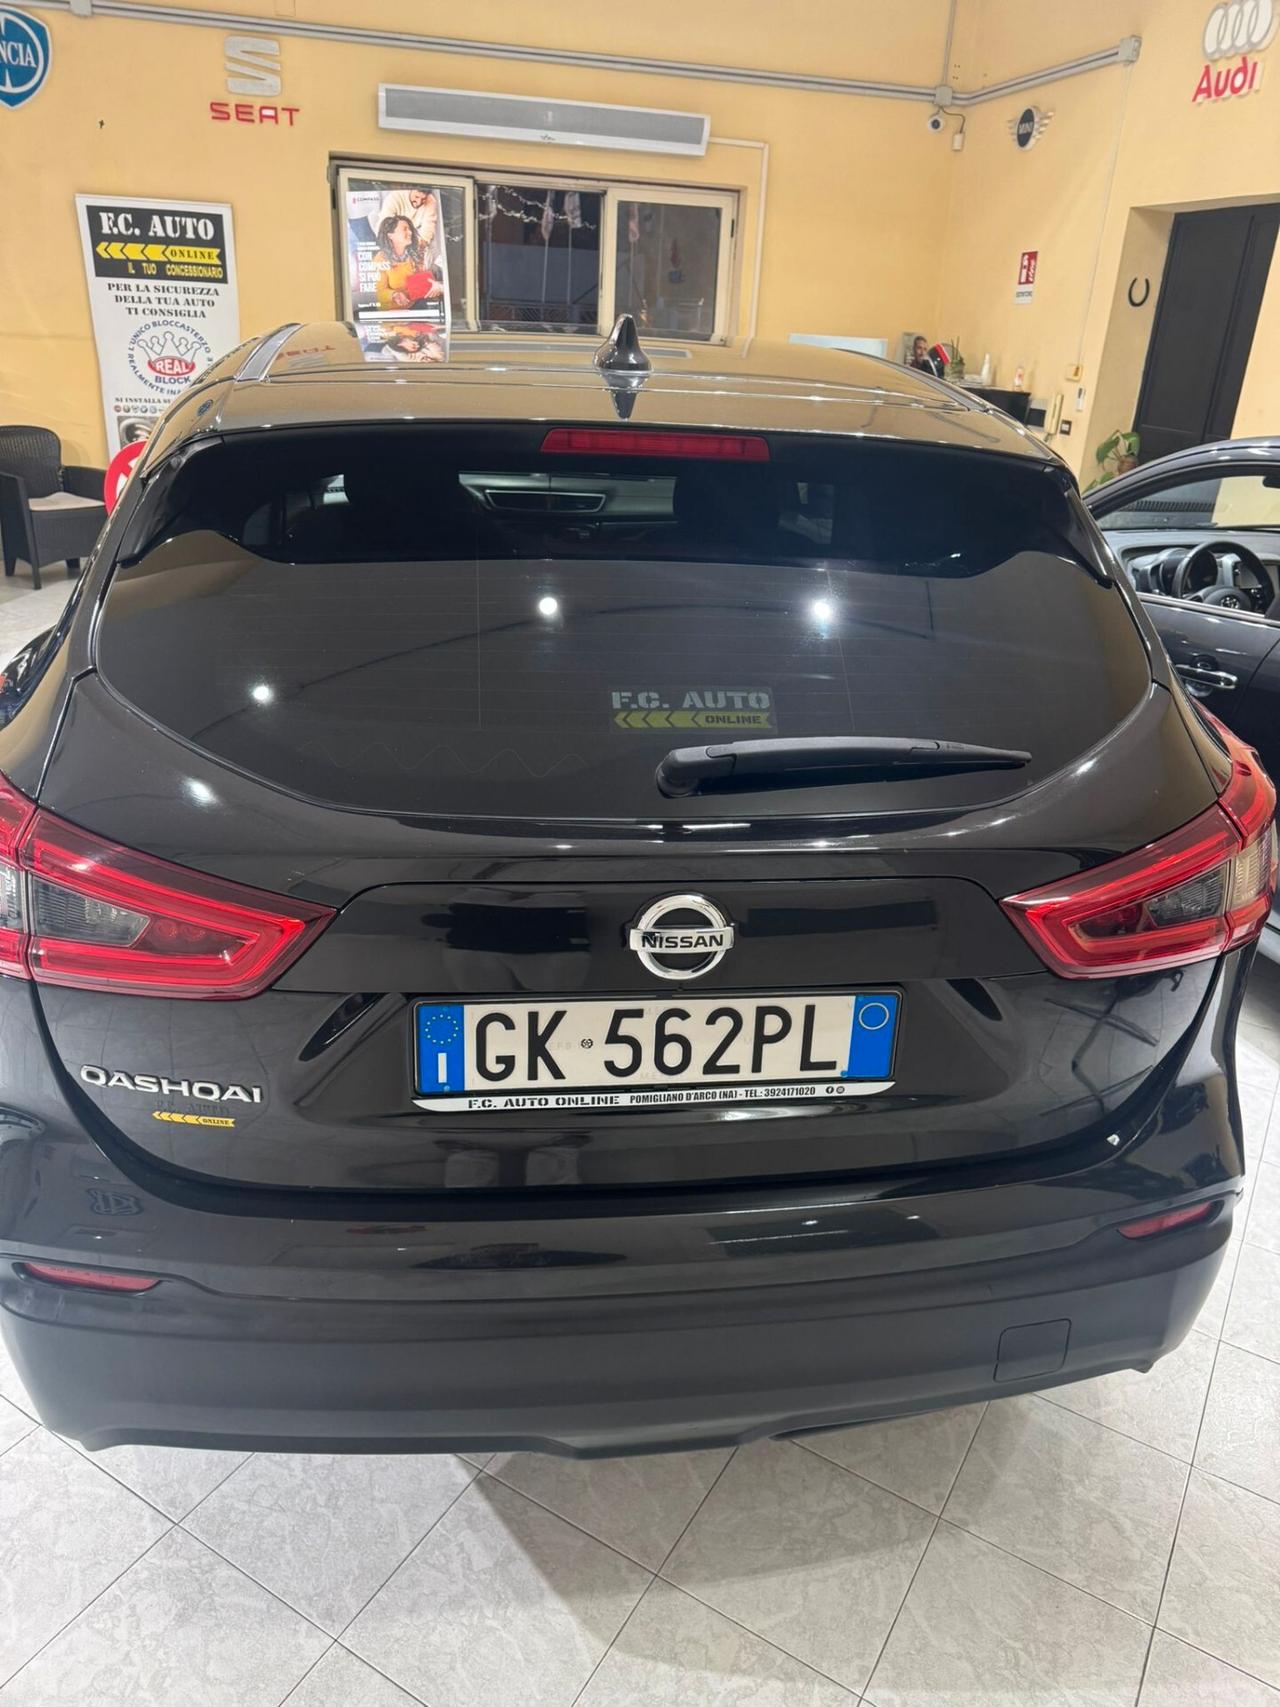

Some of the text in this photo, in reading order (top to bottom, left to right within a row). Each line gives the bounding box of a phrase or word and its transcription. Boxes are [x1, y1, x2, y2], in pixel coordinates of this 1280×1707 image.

[1192, 55, 1258, 102] Audi
[210, 102, 300, 126] SEAT
[99, 212, 215, 240] F.C. AUTO
[170, 249, 215, 260] ONLINE
[127, 262, 223, 278] IL TUO CONCESSIONARIO
[107, 283, 220, 297] PER LA SICUREZZA
[115, 295, 215, 307] DELLA TUA AUTO
[125, 307, 207, 318] TI CONSIGLIA
[152, 319, 212, 354] BLOCCASTERZO
[155, 359, 189, 375] REAL
[154, 376, 191, 384] BLOCK
[612, 691, 770, 709] F.C. AUTO
[704, 715, 762, 724] ONLINE
[641, 933, 724, 949] NISSAN
[476, 1010, 567, 1082] GK
[603, 1004, 837, 1079] 562PL
[80, 1064, 262, 1103] QASHQAI
[468, 1099, 497, 1109] F.C.
[503, 1097, 549, 1108] AUTO
[555, 1095, 620, 1106] ONLINE
[630, 1092, 684, 1104] POMIGLIANO
[685, 1090, 717, 1101] D'ARCO
[764, 1086, 816, 1097] 3924171020
